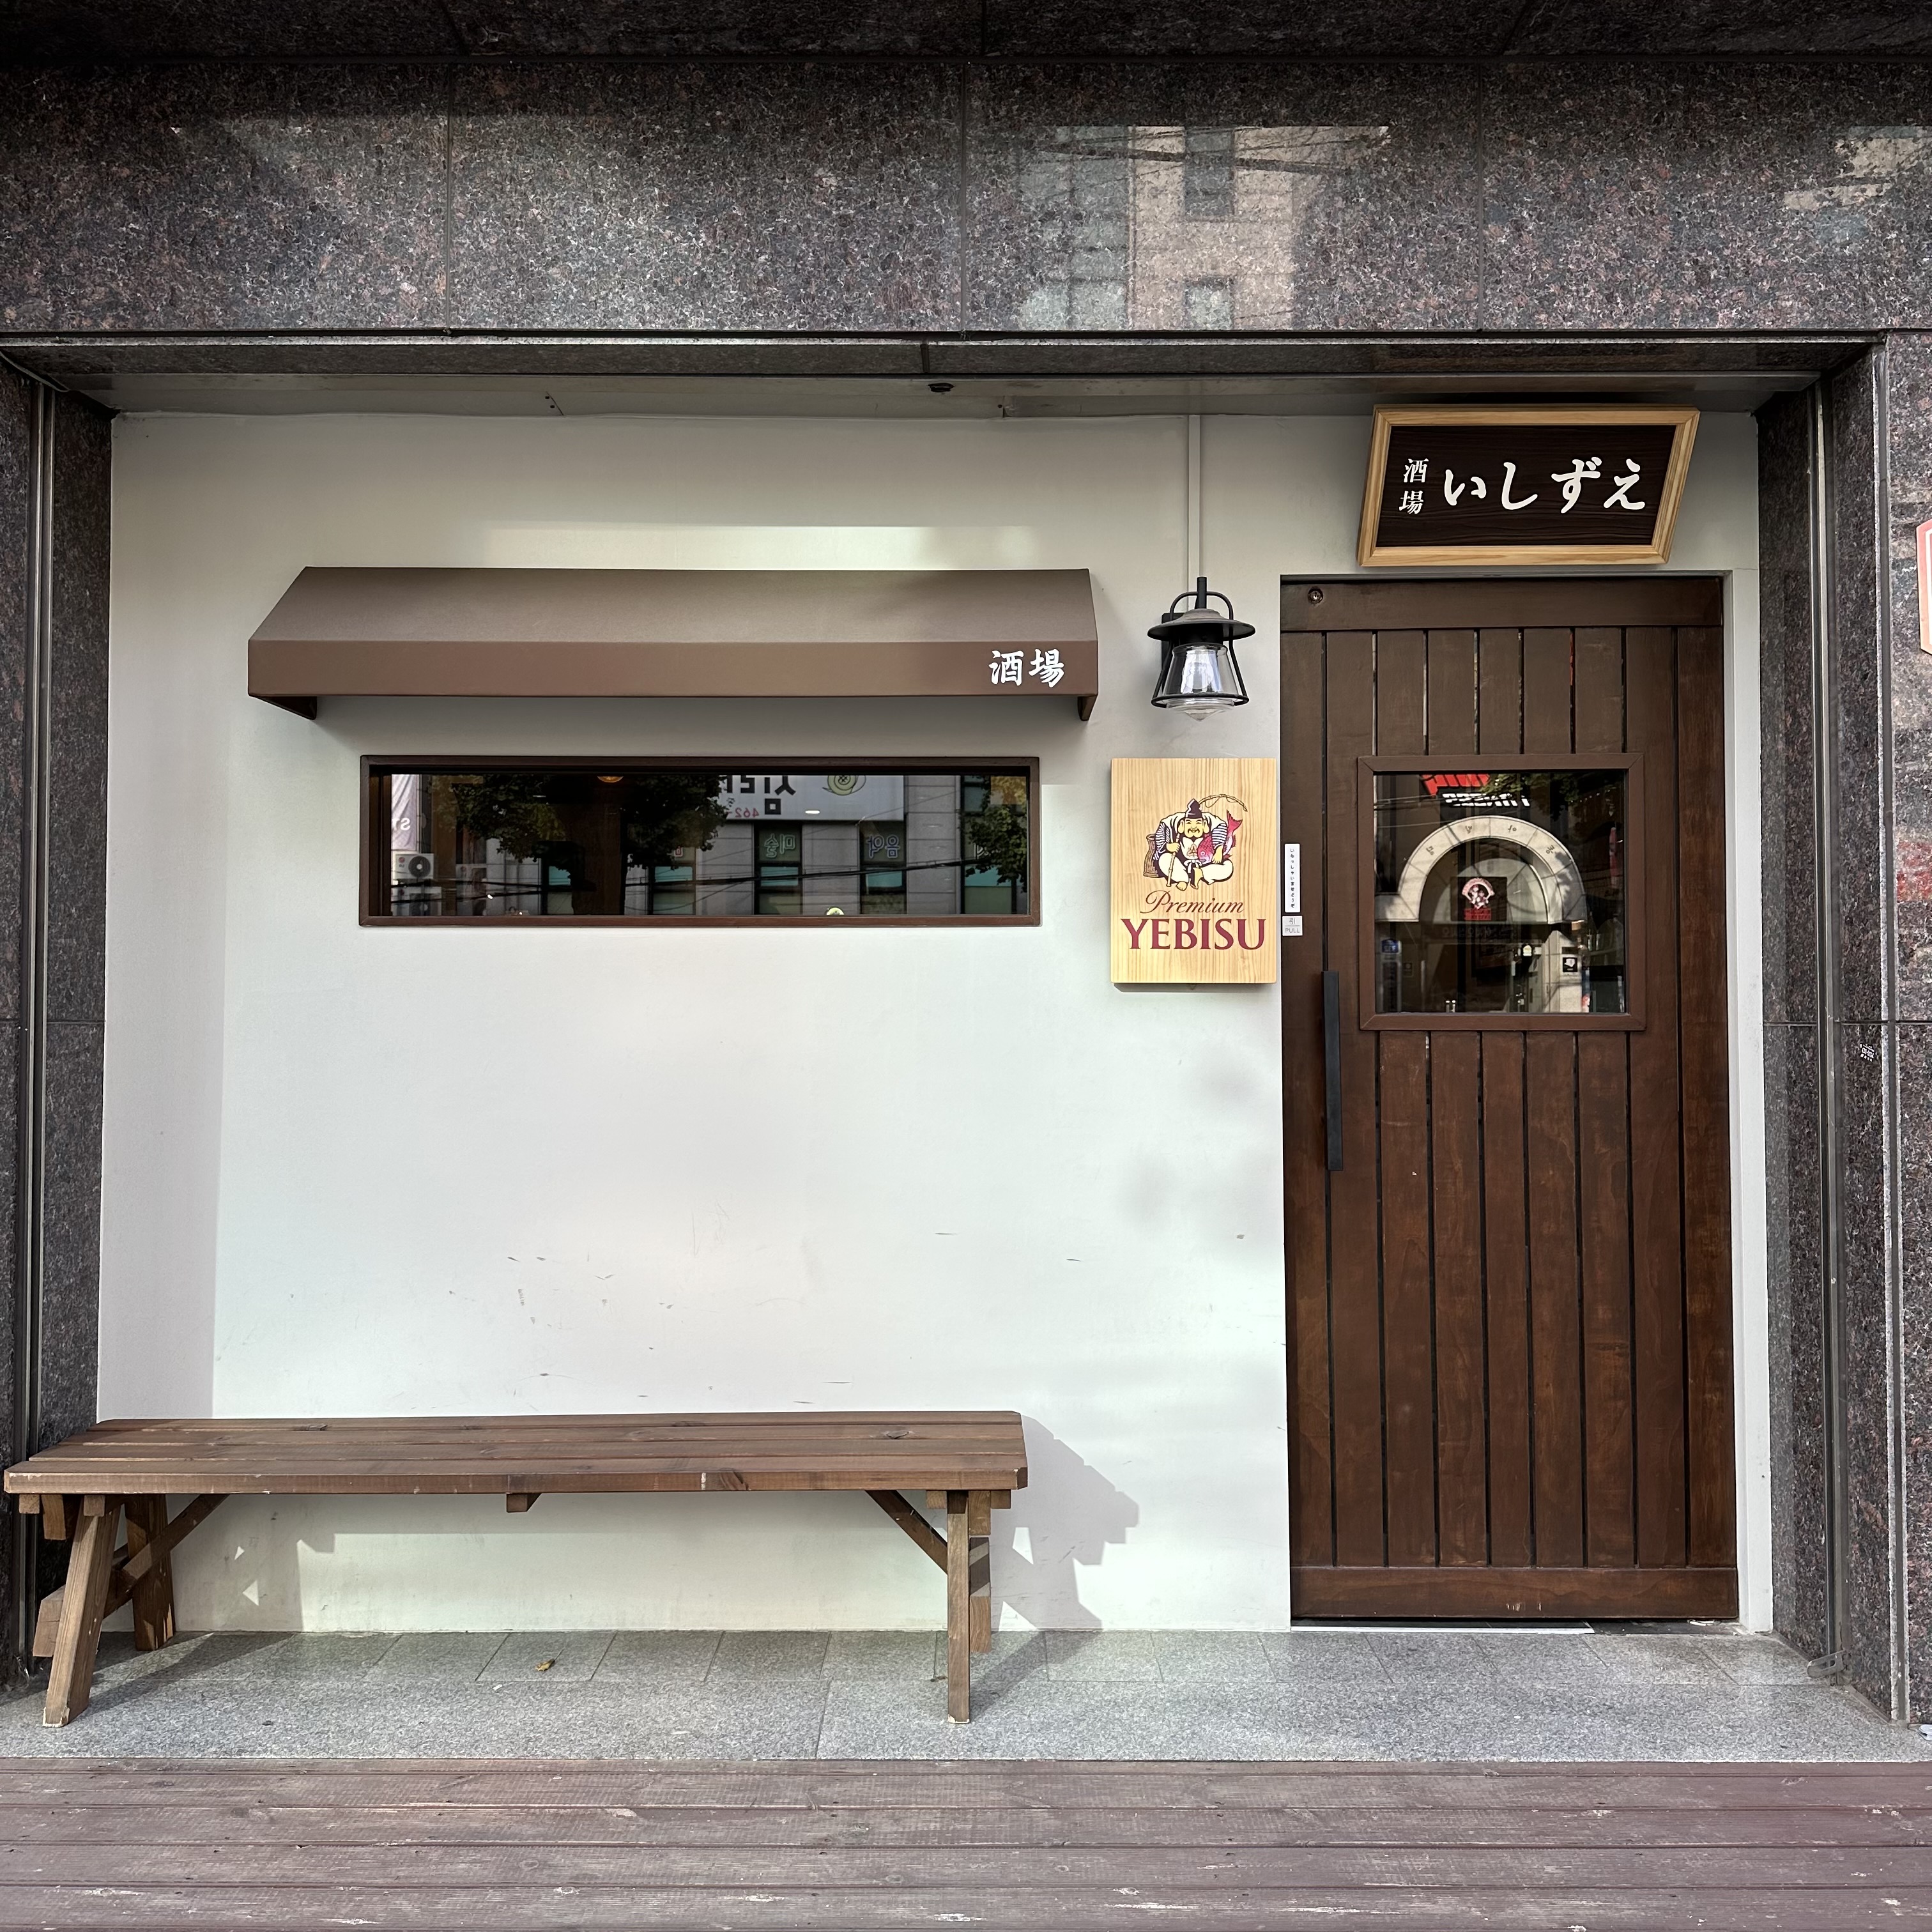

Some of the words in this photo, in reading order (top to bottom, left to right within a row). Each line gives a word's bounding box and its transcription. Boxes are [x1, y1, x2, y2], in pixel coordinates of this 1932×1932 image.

[1399, 458, 1429, 514] 酒場
[1444, 456, 1646, 514] いしずえ
[989, 648, 1064, 687] 酒場
[1140, 890, 1245, 914] Premium
[1120, 918, 1266, 950] YEBISU
